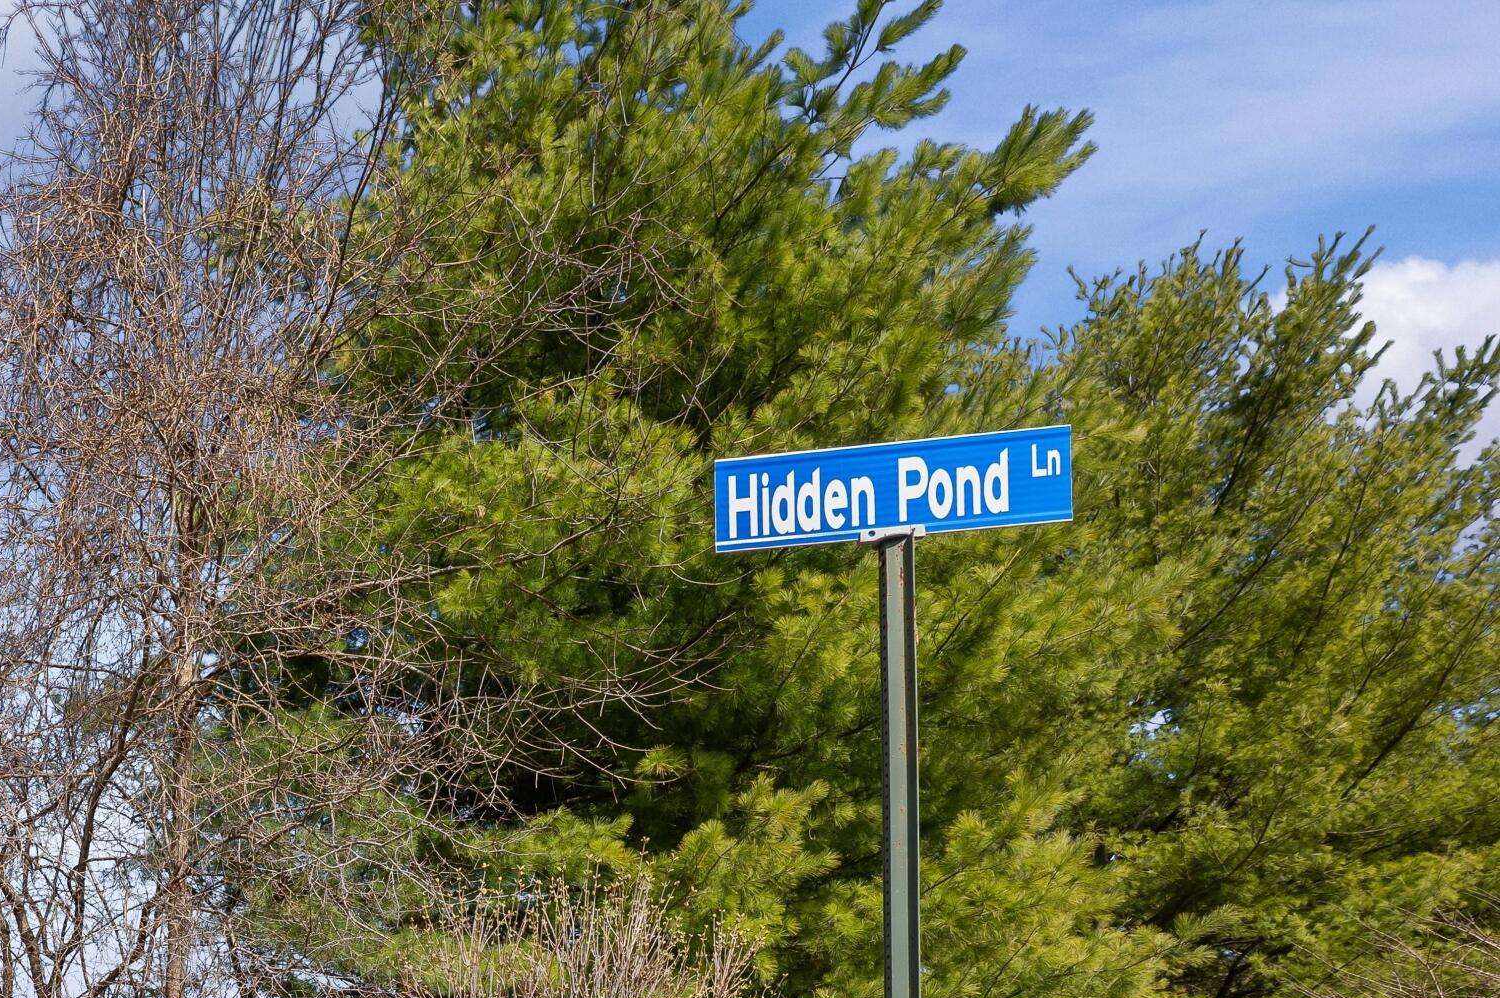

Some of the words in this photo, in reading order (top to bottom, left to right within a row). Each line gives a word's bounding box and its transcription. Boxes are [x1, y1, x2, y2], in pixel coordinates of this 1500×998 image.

[728, 467, 876, 539] Hidden
[898, 447, 1010, 522] Pond
[1031, 444, 1061, 477] Ln
